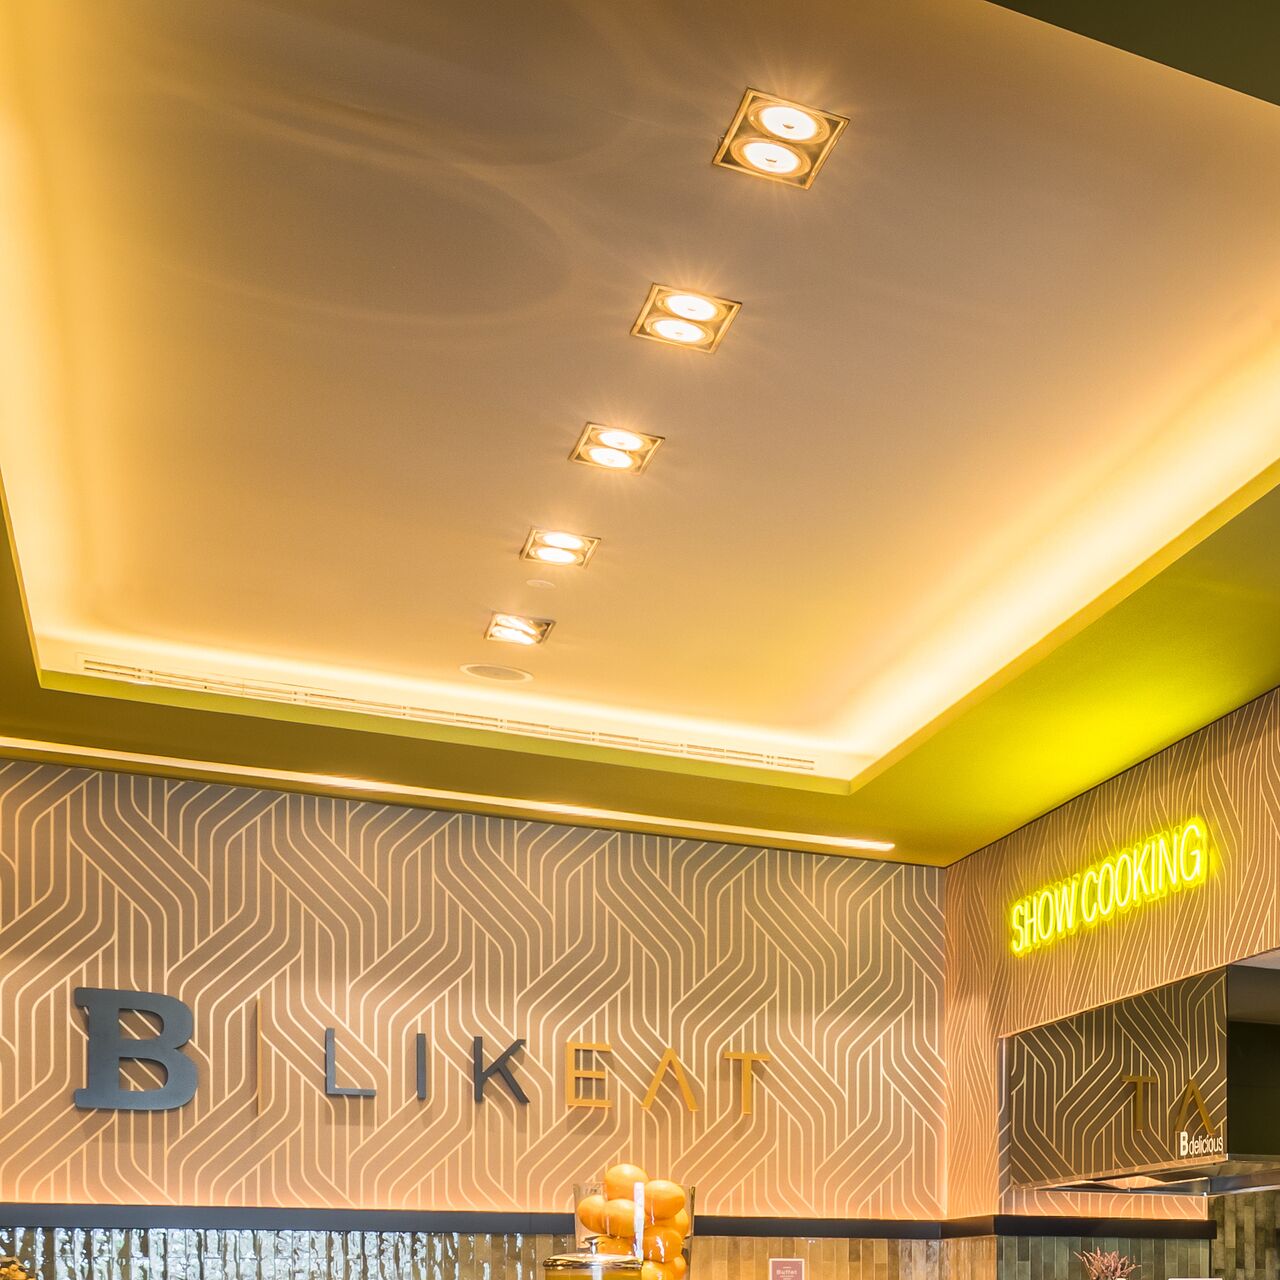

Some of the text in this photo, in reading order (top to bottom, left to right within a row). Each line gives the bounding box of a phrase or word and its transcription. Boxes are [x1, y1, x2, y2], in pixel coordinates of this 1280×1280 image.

[1011, 821, 1204, 954] SHOW COOKING
[73, 987, 199, 1111] B
